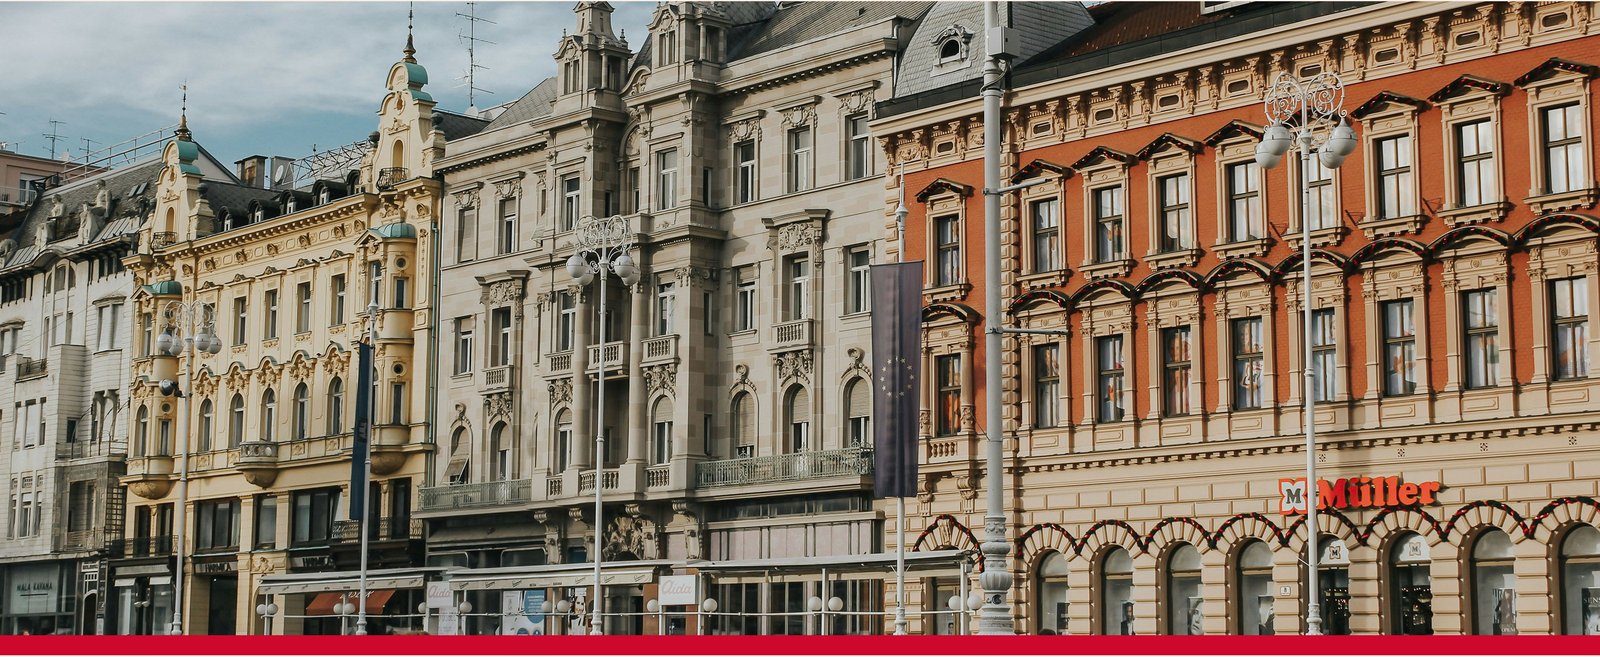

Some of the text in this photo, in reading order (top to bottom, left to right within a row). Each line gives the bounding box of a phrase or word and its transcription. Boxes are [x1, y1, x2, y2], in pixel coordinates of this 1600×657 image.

[1316, 475, 1440, 511] Müller
[17, 582, 52, 591] MALA KAVANA
